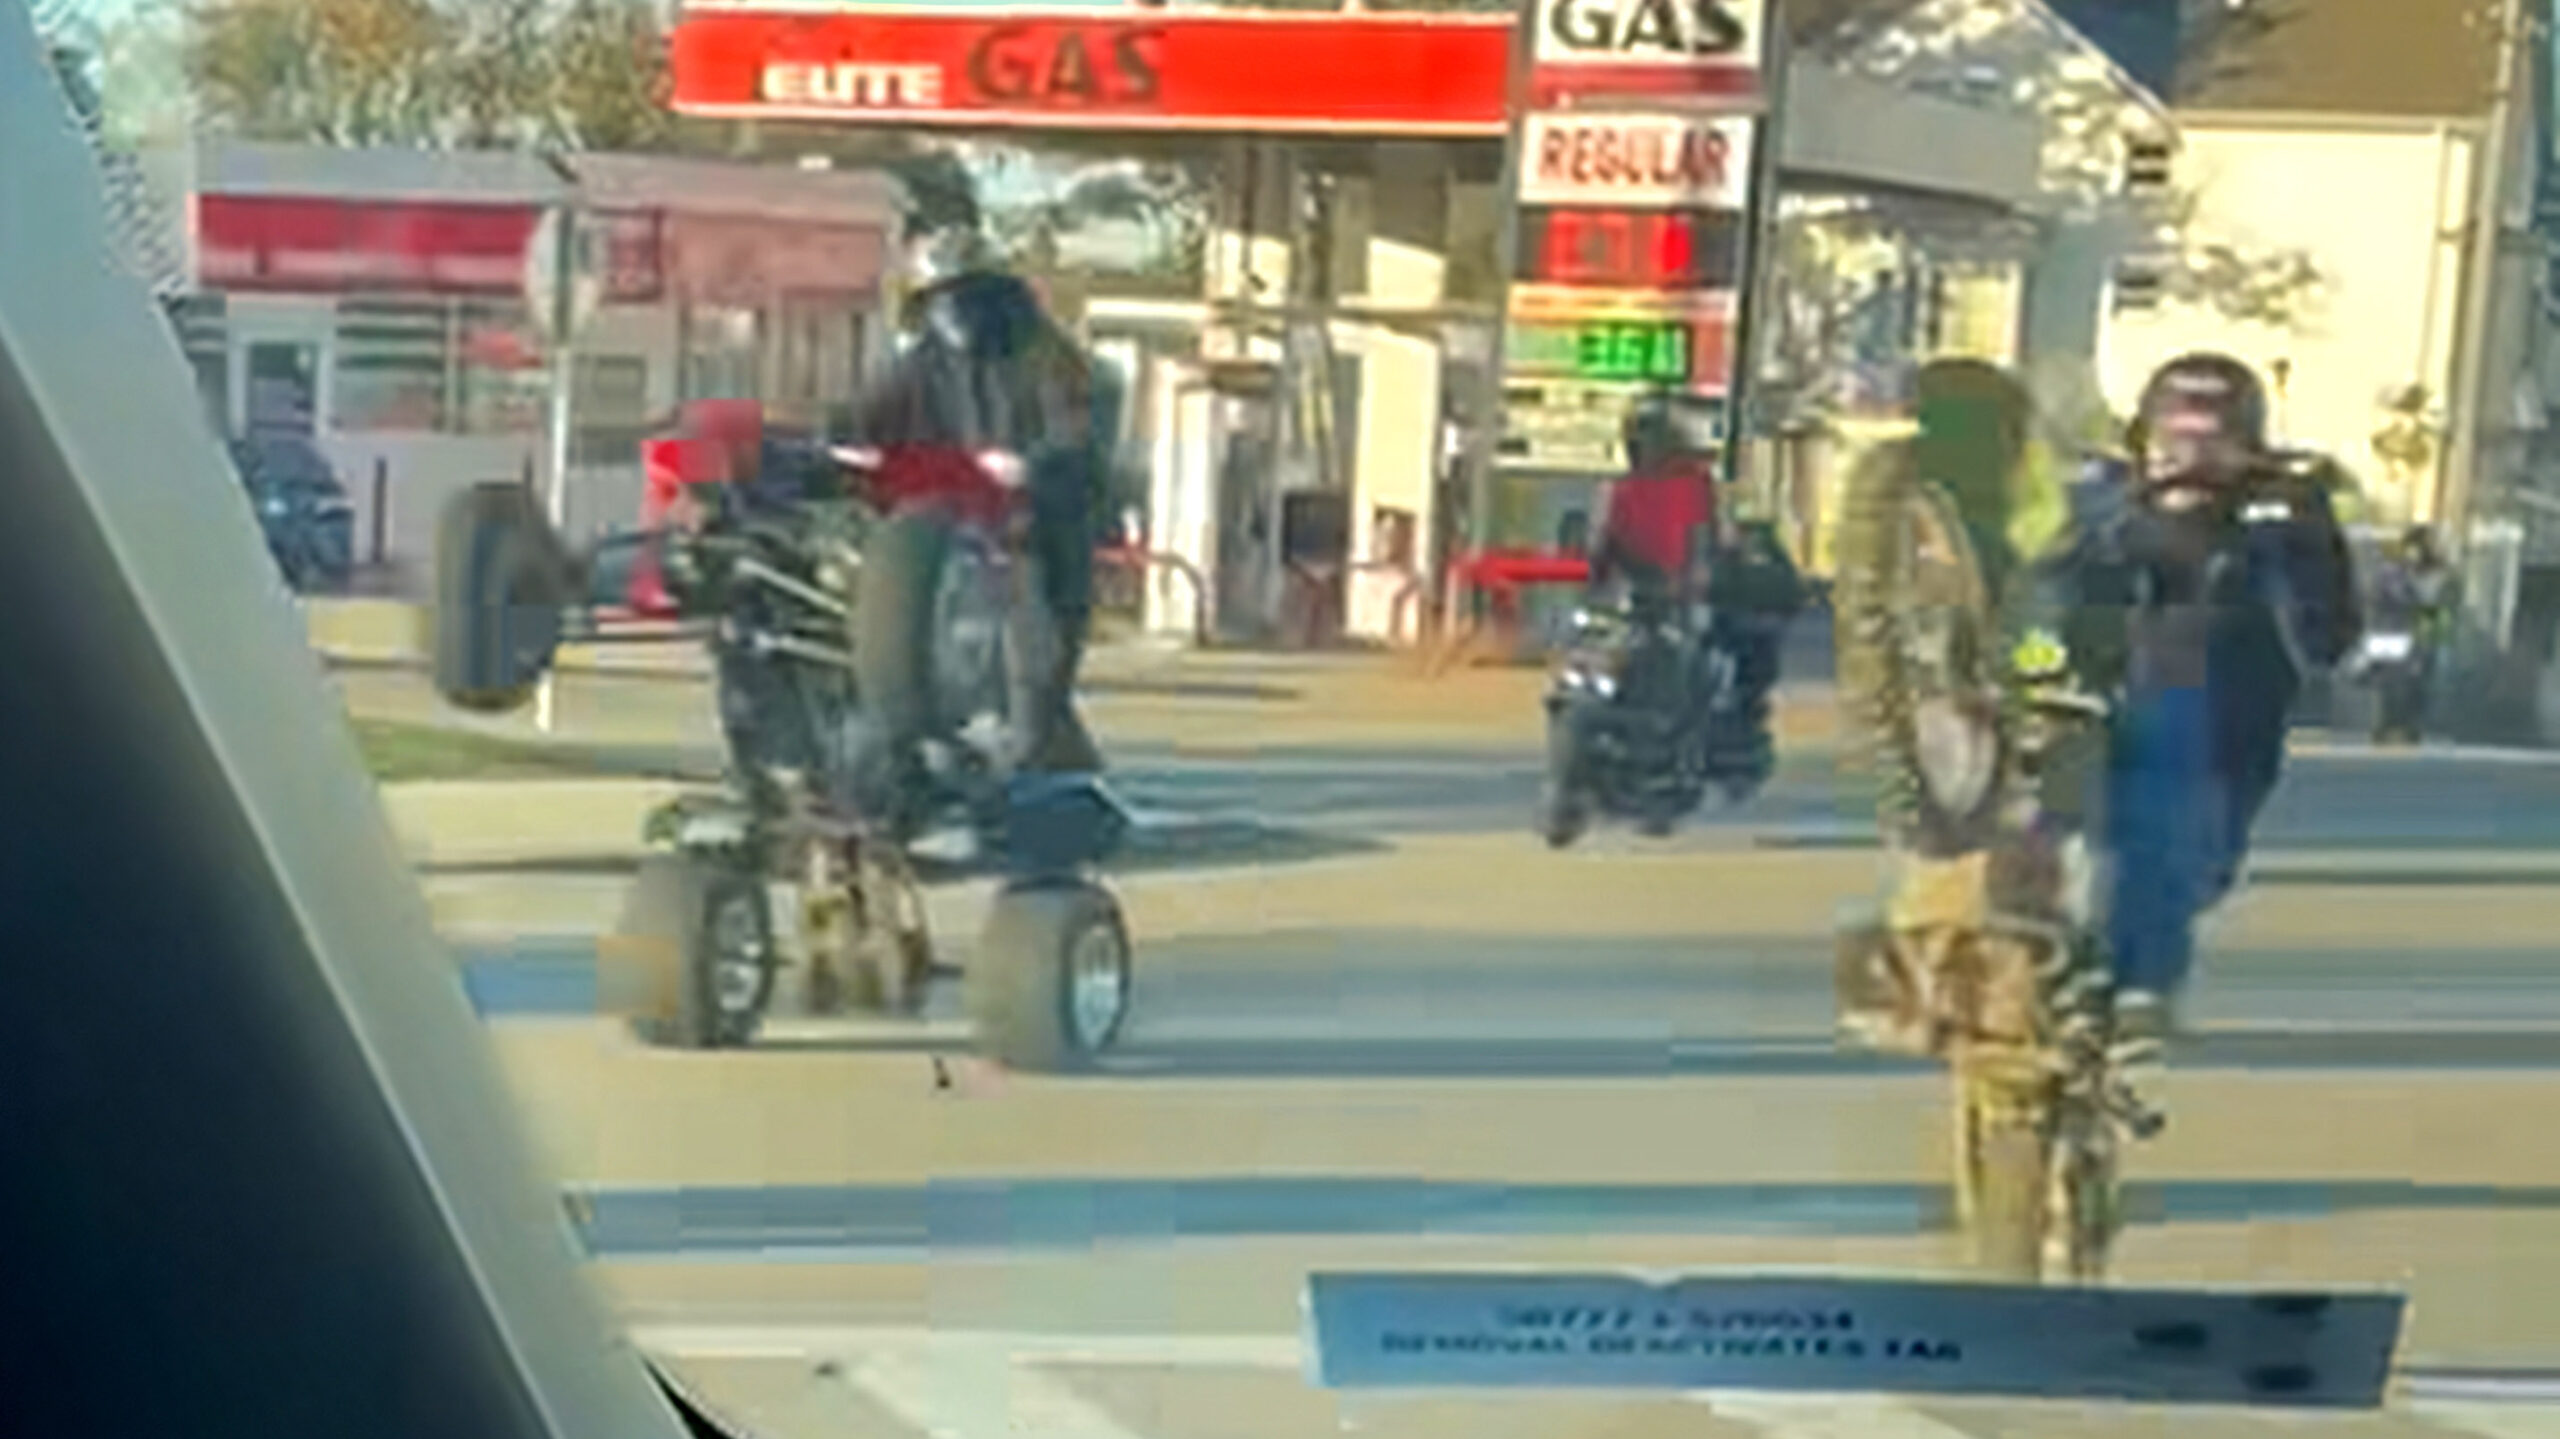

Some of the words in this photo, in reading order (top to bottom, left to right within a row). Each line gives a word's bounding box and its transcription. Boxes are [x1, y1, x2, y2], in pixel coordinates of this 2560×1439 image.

[1550, 0, 1746, 53] GAS
[763, 63, 942, 105] ELITE
[966, 24, 1163, 102] GAS
[1538, 126, 1730, 188] REGULAR
[1380, 1331, 1569, 1354] REMOVAL
[1587, 1334, 1866, 1358] DEACTIVATES
[1885, 1338, 1963, 1362] TAG
